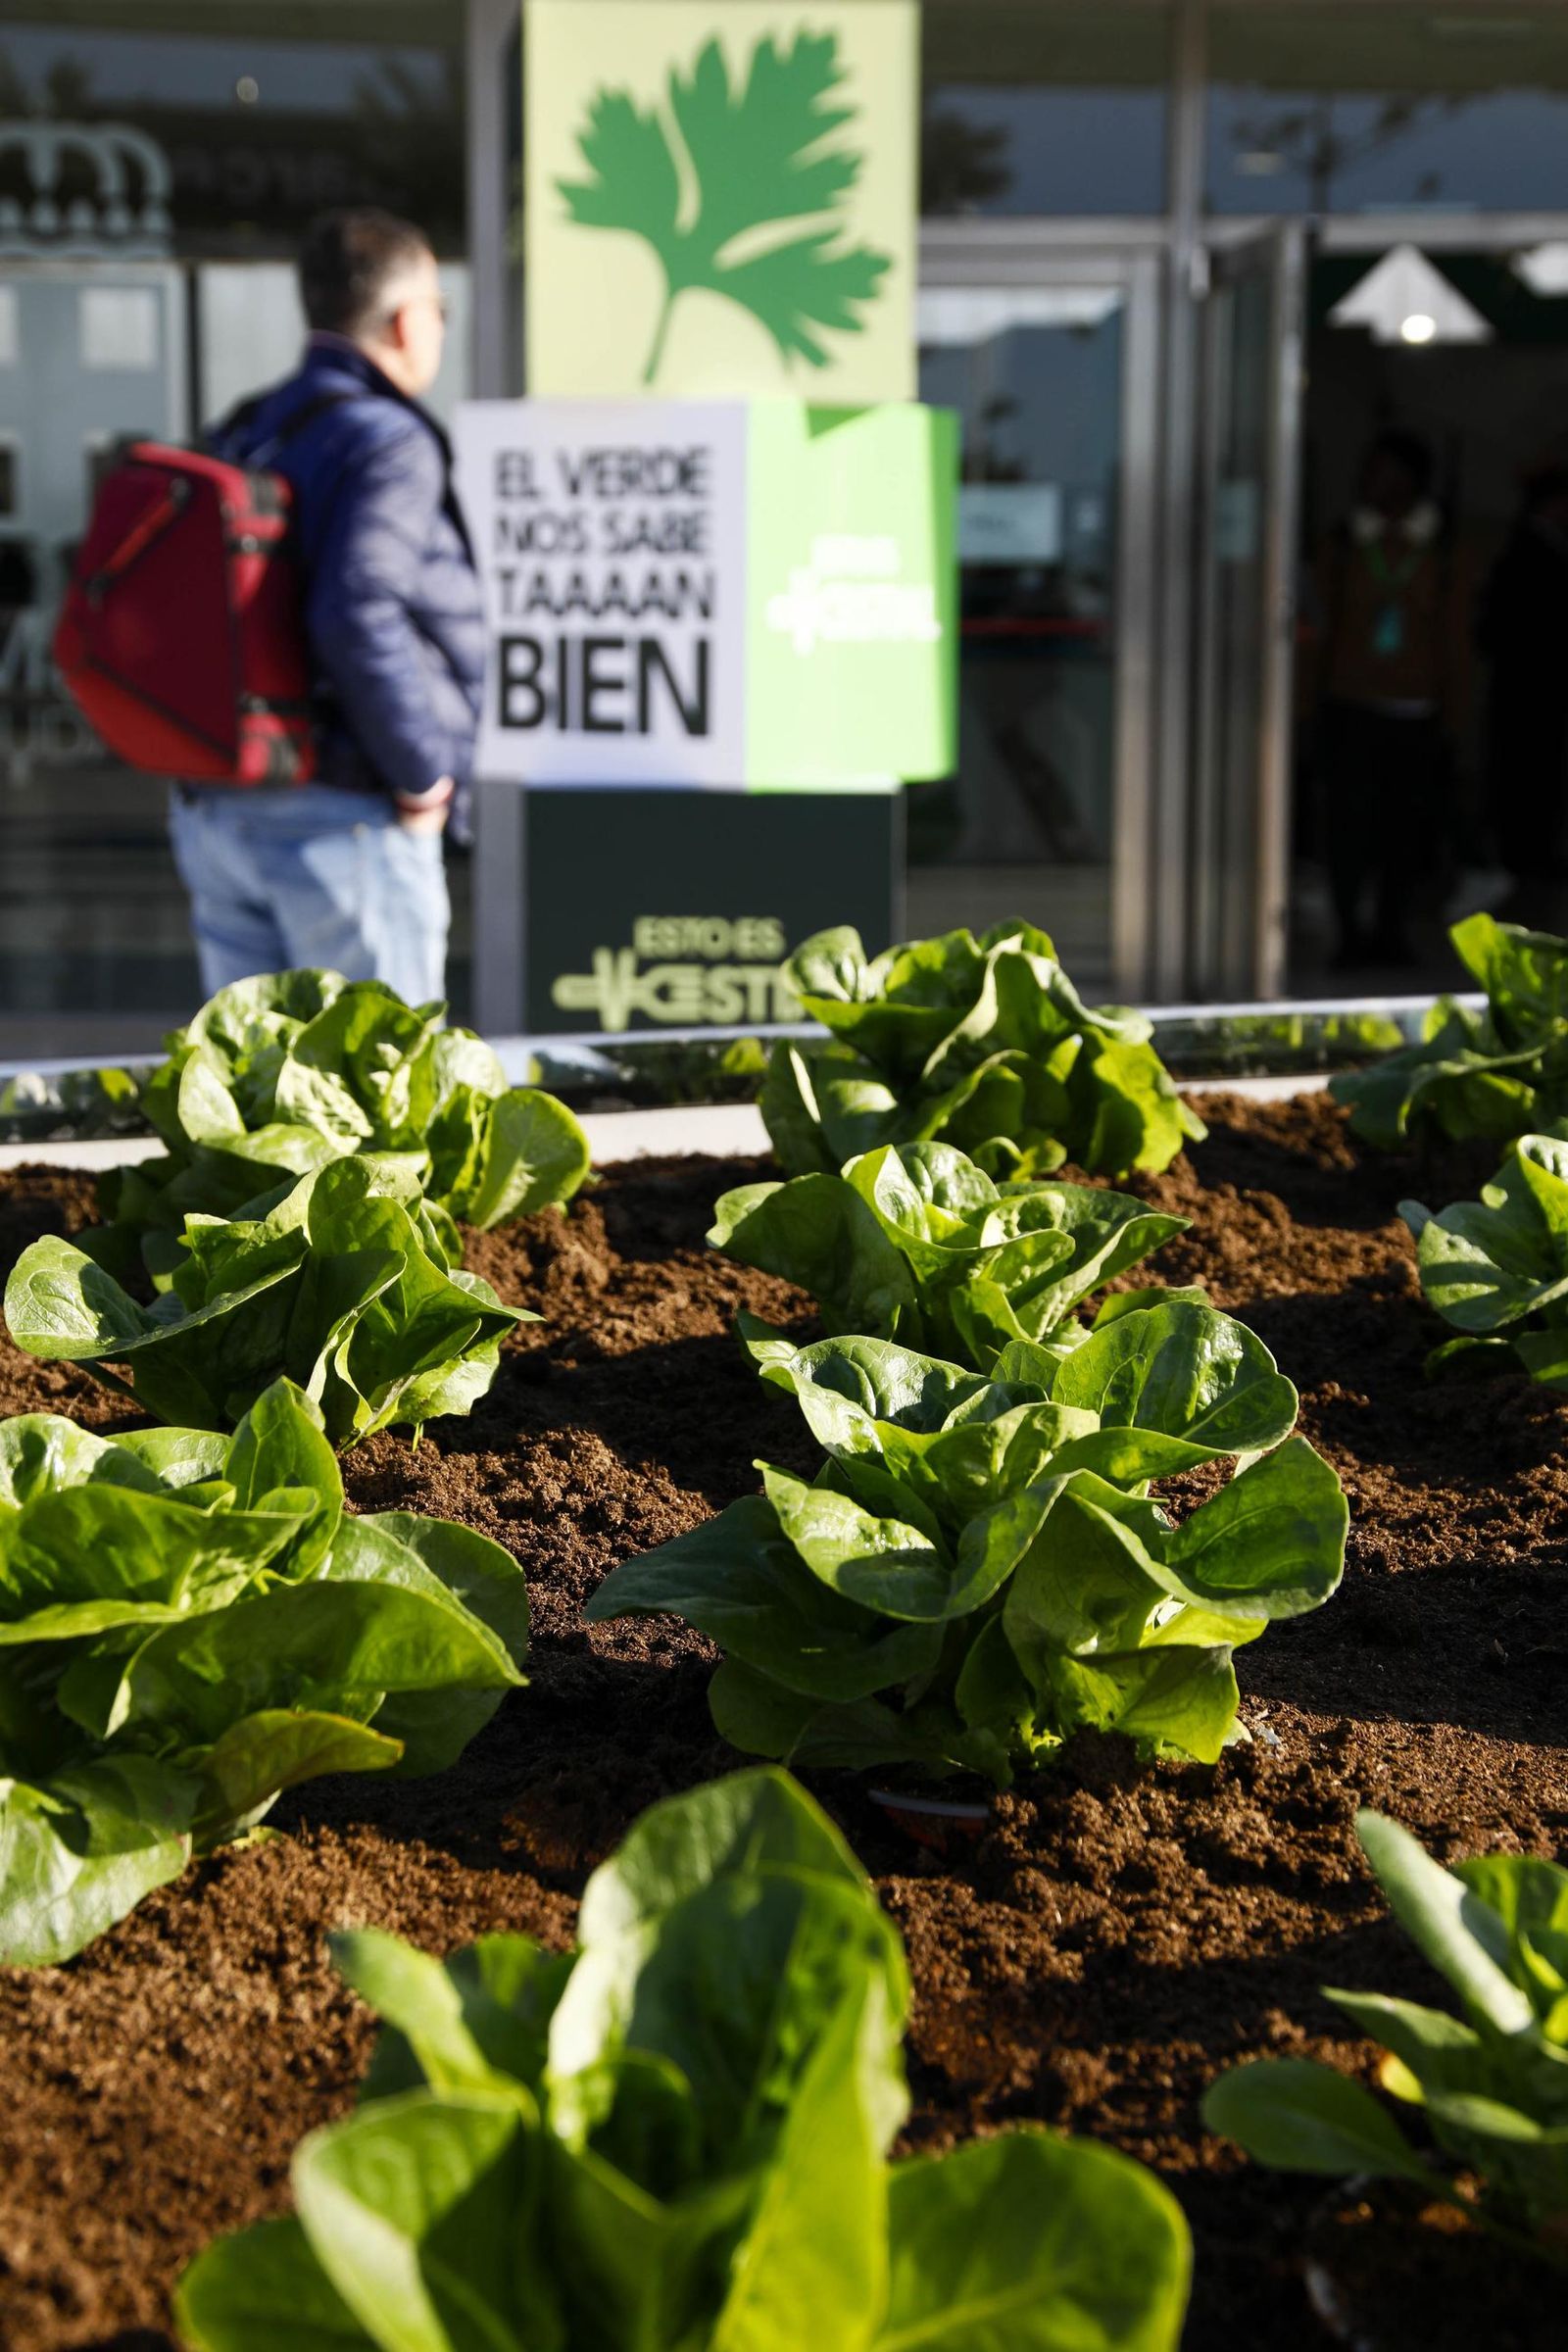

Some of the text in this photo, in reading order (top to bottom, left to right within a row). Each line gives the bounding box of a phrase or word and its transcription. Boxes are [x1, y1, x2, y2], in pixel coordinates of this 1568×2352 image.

[495, 446, 708, 498] EL VERDE
[494, 510, 706, 555] NOS SABE
[498, 566, 714, 619] TAAAAN
[498, 634, 709, 736] BIEN
[634, 915, 784, 959] ESTO ES
